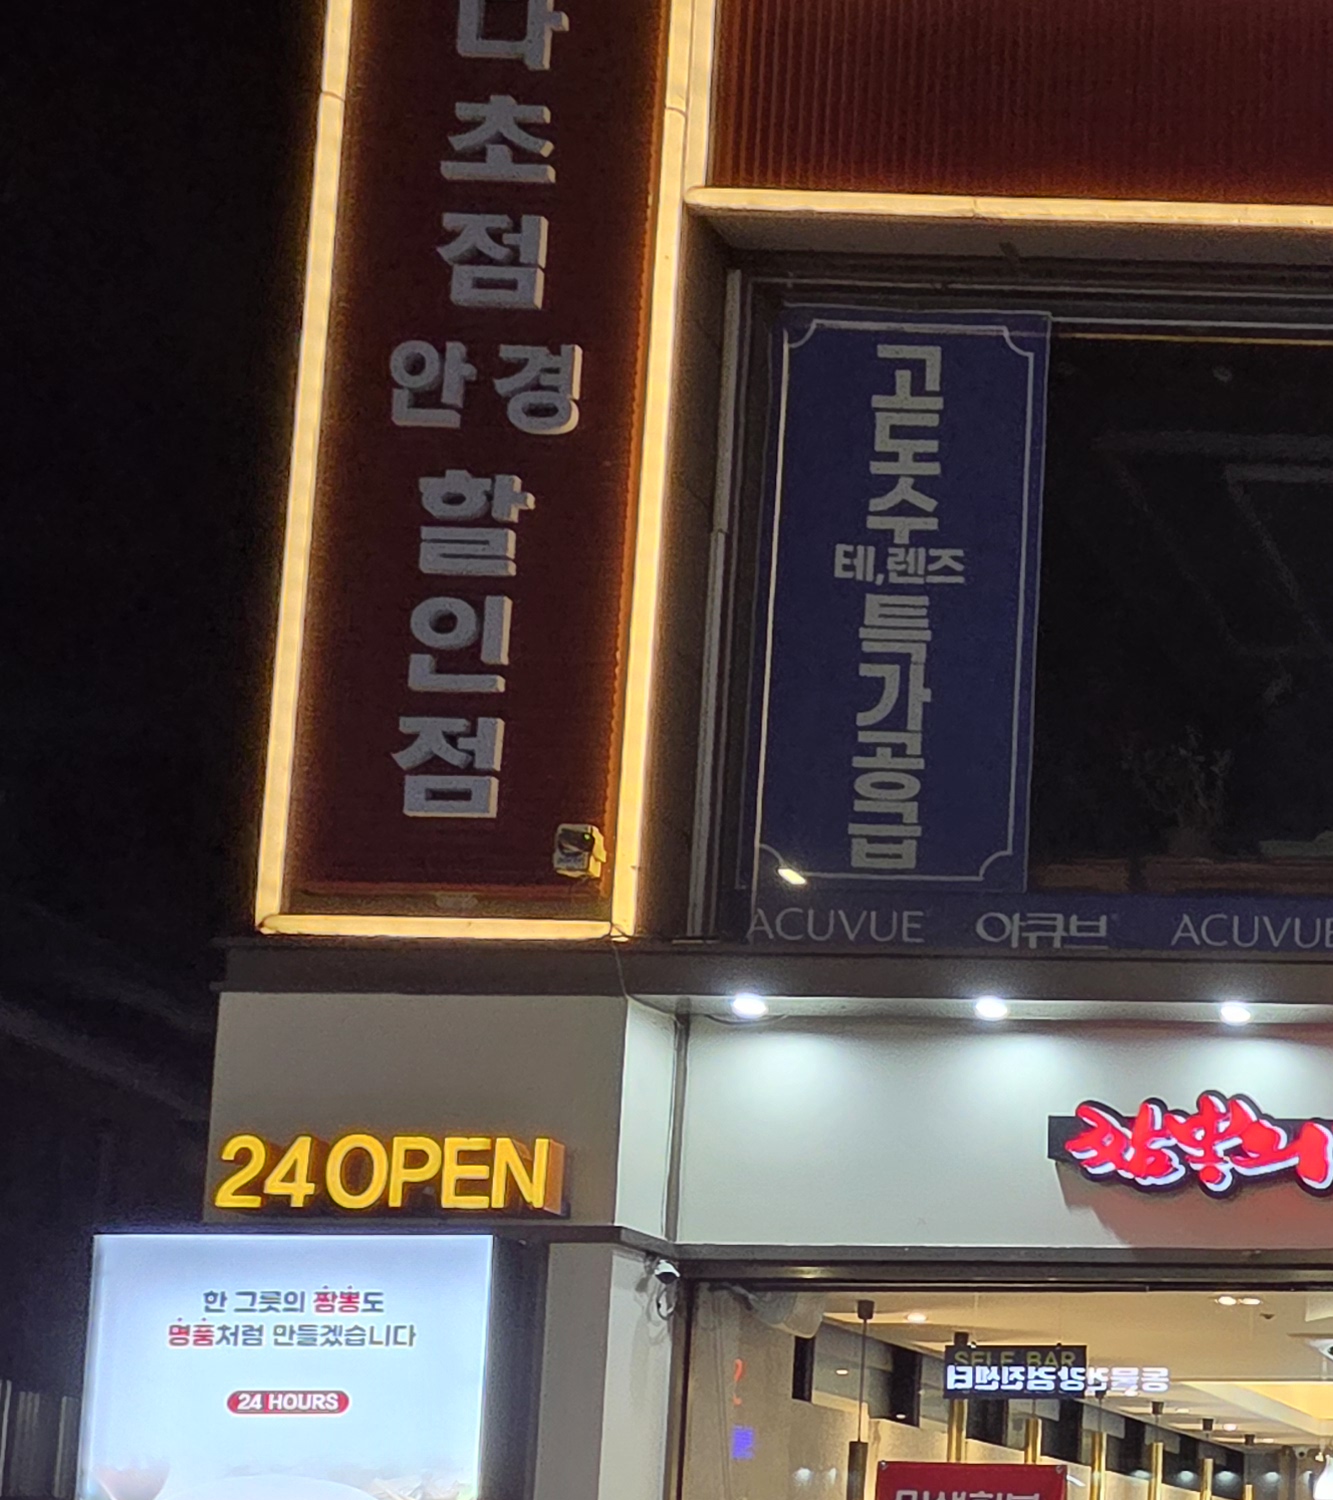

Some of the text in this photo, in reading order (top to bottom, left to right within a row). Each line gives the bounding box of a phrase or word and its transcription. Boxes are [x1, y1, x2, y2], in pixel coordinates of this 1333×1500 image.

[389, 340, 583, 436] 안경
[391, 469, 535, 819] 할인점
[747, 908, 925, 943] ACUVUE
[976, 911, 1110, 949] 아큐브
[202, 1286, 386, 1314] 한 그릇의 짬뽕도
[167, 1321, 417, 1348] 명품처럼 만들겠습니다
[237, 1392, 339, 1411] 24 HOURS
